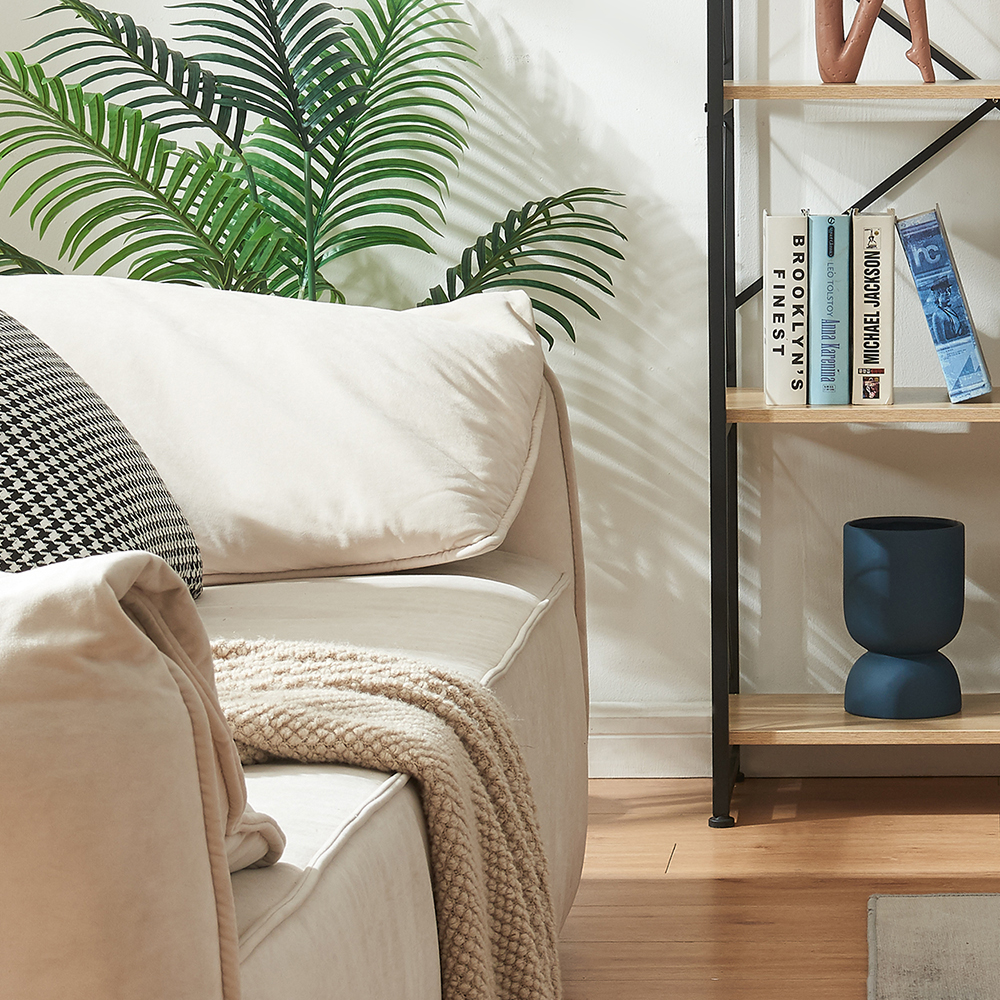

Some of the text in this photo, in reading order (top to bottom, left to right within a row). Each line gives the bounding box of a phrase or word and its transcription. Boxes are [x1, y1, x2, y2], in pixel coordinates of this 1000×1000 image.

[826, 262, 835, 278] LEO
[864, 250, 881, 308] JACKSON
[772, 269, 786, 356] FINEST
[791, 235, 805, 391] BROOKLYN'S
[826, 280, 835, 317] TOLSTOY
[822, 319, 840, 340] Anna
[863, 311, 880, 365] MICHAEL
[820, 343, 840, 382] Karenina
